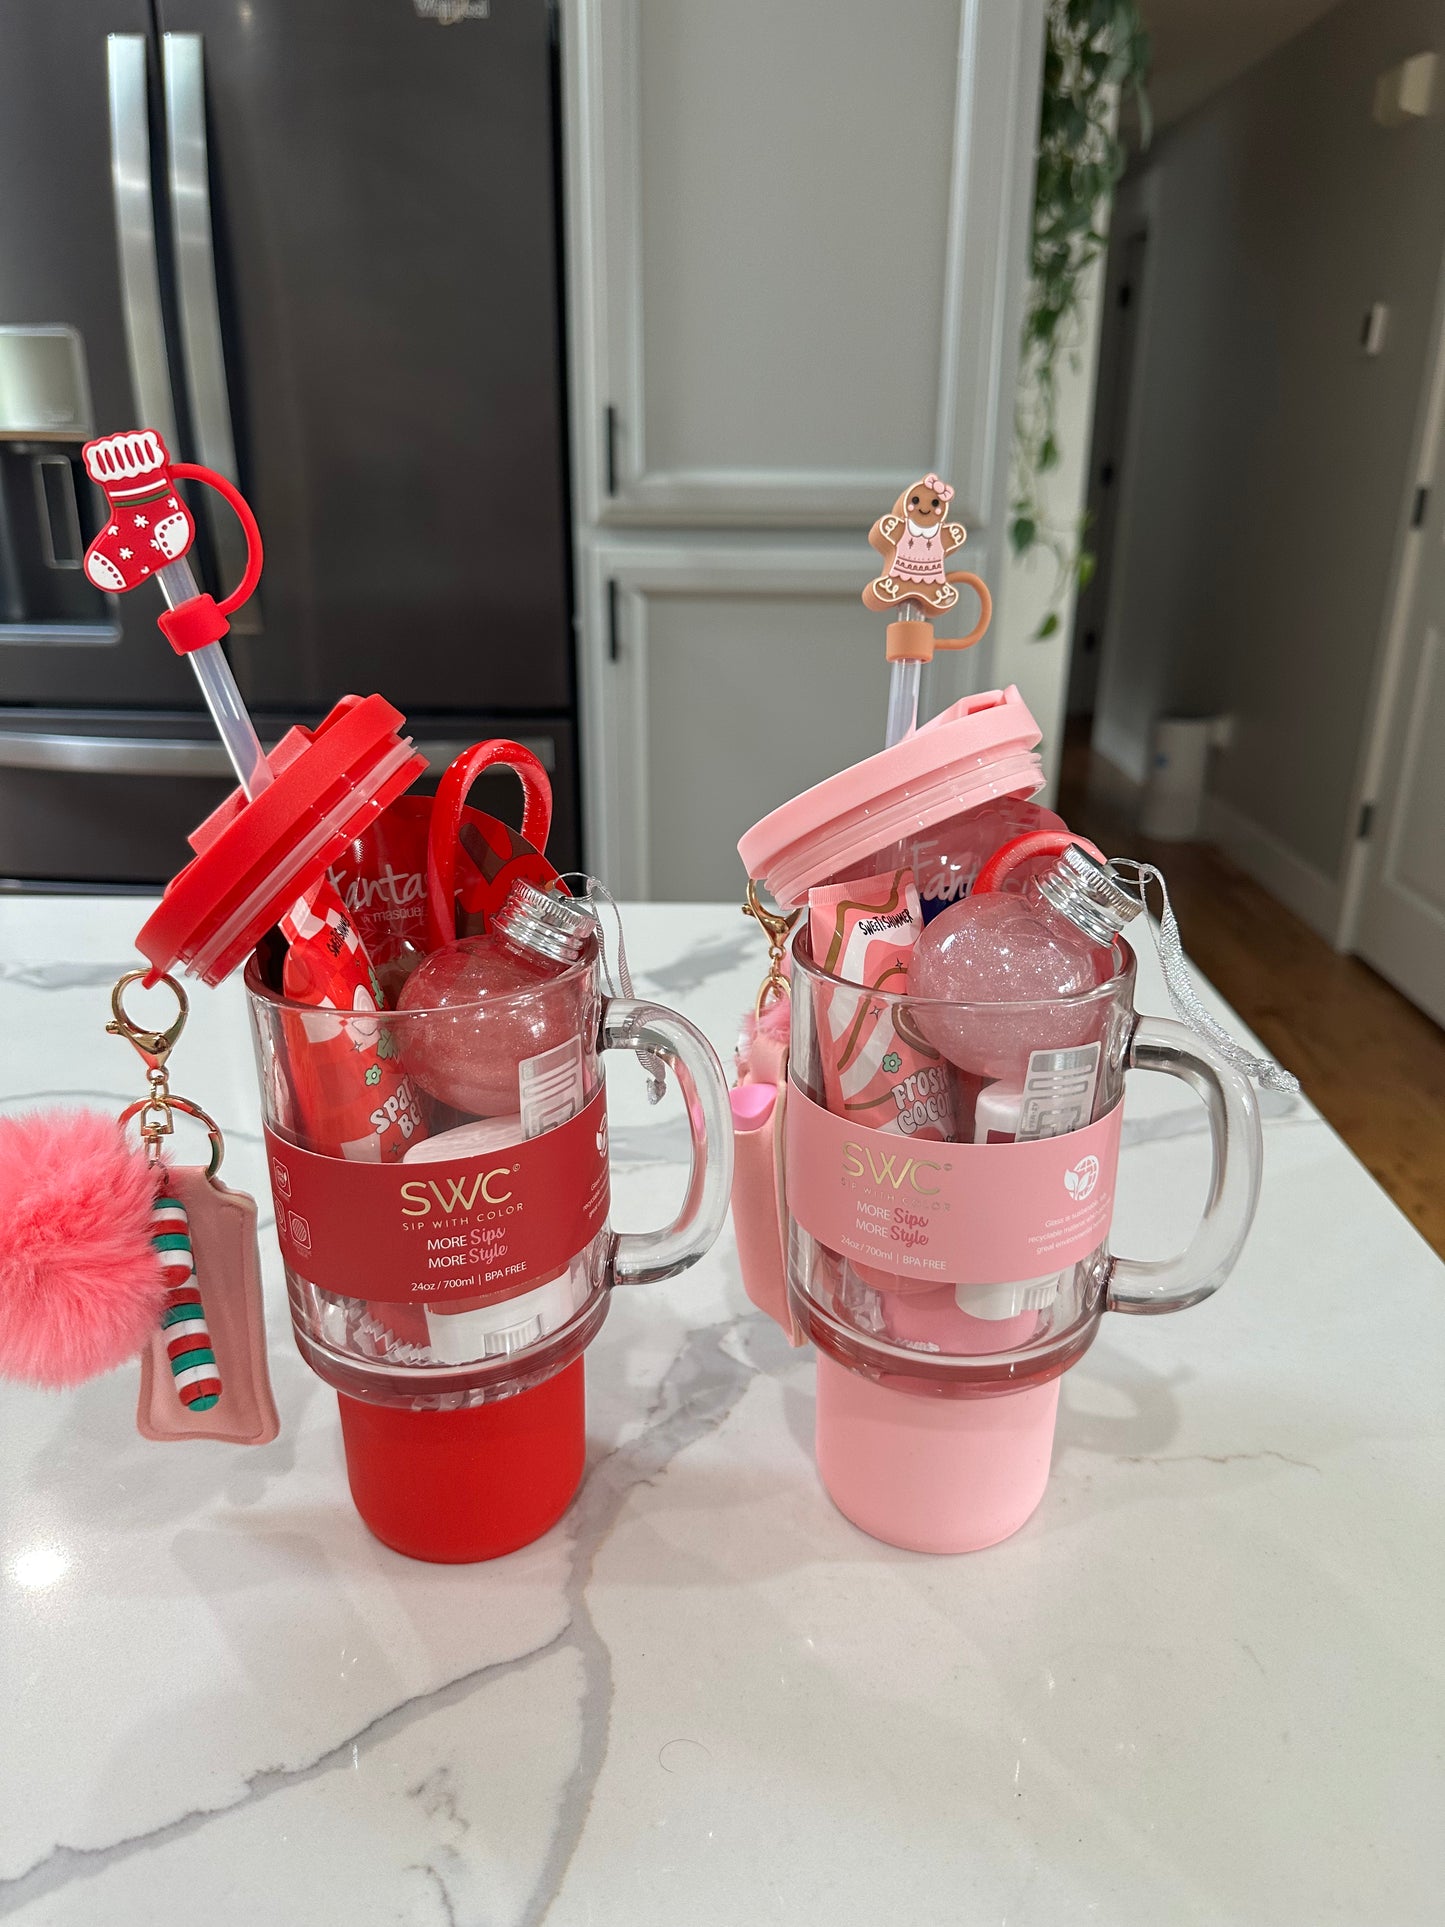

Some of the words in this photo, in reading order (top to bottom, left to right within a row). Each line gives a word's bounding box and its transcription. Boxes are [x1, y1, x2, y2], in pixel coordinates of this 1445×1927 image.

[402, 1221, 425, 1231] SIP
[432, 1217, 469, 1229] WITH
[476, 1202, 524, 1222] COLOR
[856, 1200, 891, 1221] MORE
[893, 1207, 929, 1230] Sips
[427, 1234, 467, 1251] MORE
[470, 1227, 506, 1246] Sips
[855, 1218, 889, 1239] MORE
[890, 1225, 929, 1248] Style
[428, 1253, 467, 1269] MORE
[469, 1243, 509, 1265] Style
[902, 1255, 921, 1267] BPA
[922, 1258, 946, 1271] FREE
[411, 1281, 436, 1292] 24oz
[443, 1275, 474, 1290] 700ml
[485, 1268, 503, 1283] BPA
[505, 1260, 527, 1276] FREE
